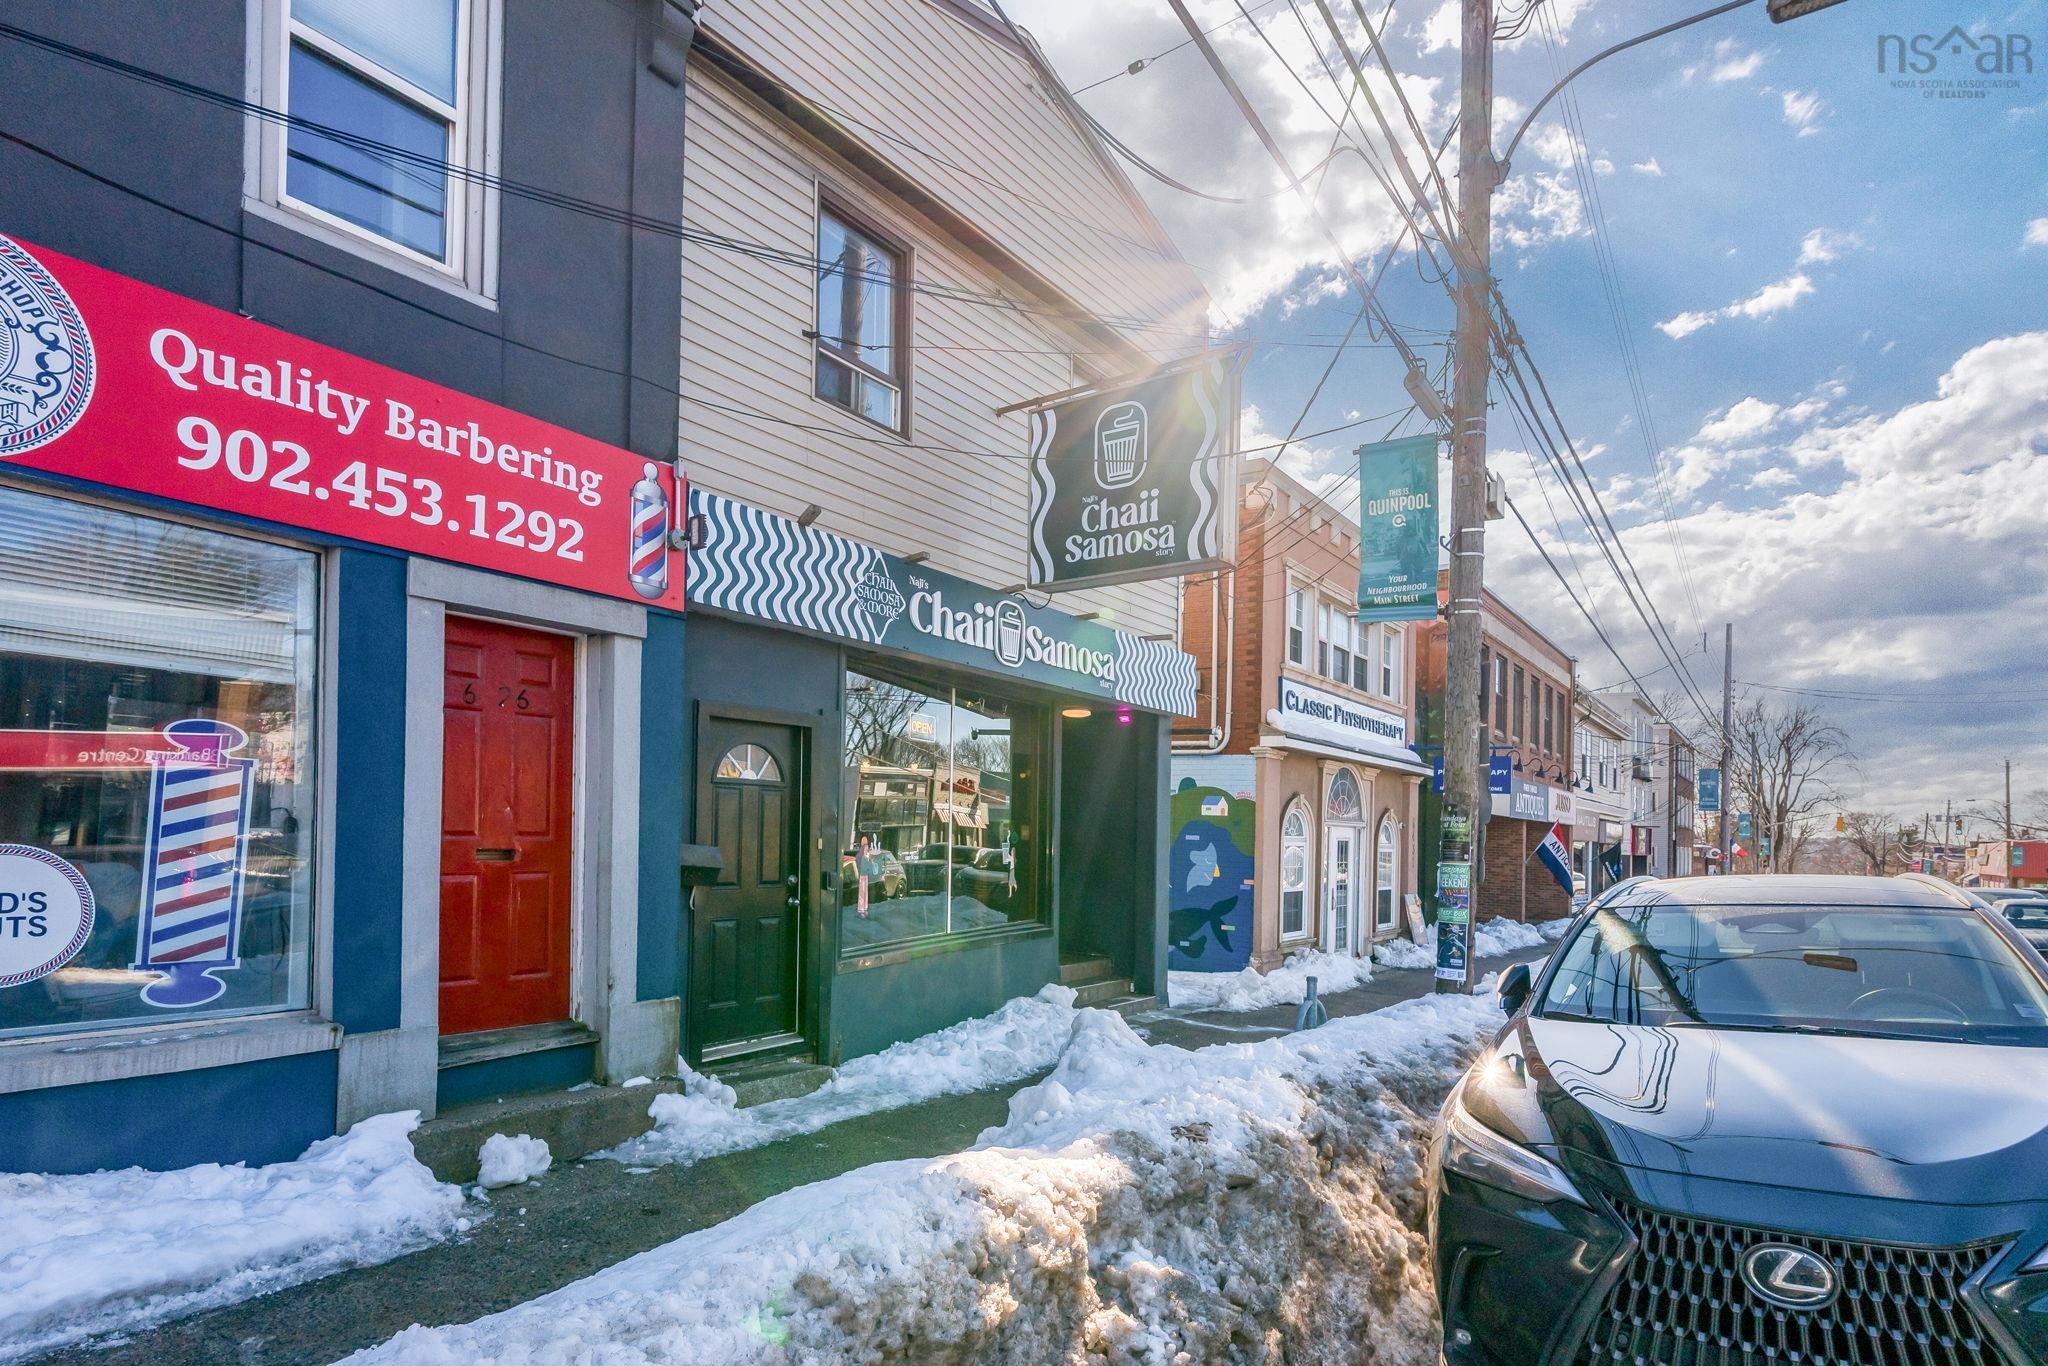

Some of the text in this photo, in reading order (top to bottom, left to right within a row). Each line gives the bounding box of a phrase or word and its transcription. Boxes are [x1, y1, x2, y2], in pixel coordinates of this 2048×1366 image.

[150, 328, 603, 507] Quality Barbering
[177, 416, 584, 562] 902.453.1292
[1389, 487, 1409, 497] THIS IS
[1368, 493, 1432, 516] QUINPOOL
[1065, 524, 1176, 563] Samosa
[1155, 548, 1176, 557] story
[909, 575, 929, 590] Naji's
[857, 584, 900, 607] SAMOSA
[858, 598, 900, 620] & MORE
[909, 591, 1116, 682] Chaii Samosa
[1099, 680, 1115, 690] story
[911, 719, 934, 735] OPEN
[1515, 792, 1545, 818] ANTIQUES
[1441, 878, 1468, 888] EEKEND
